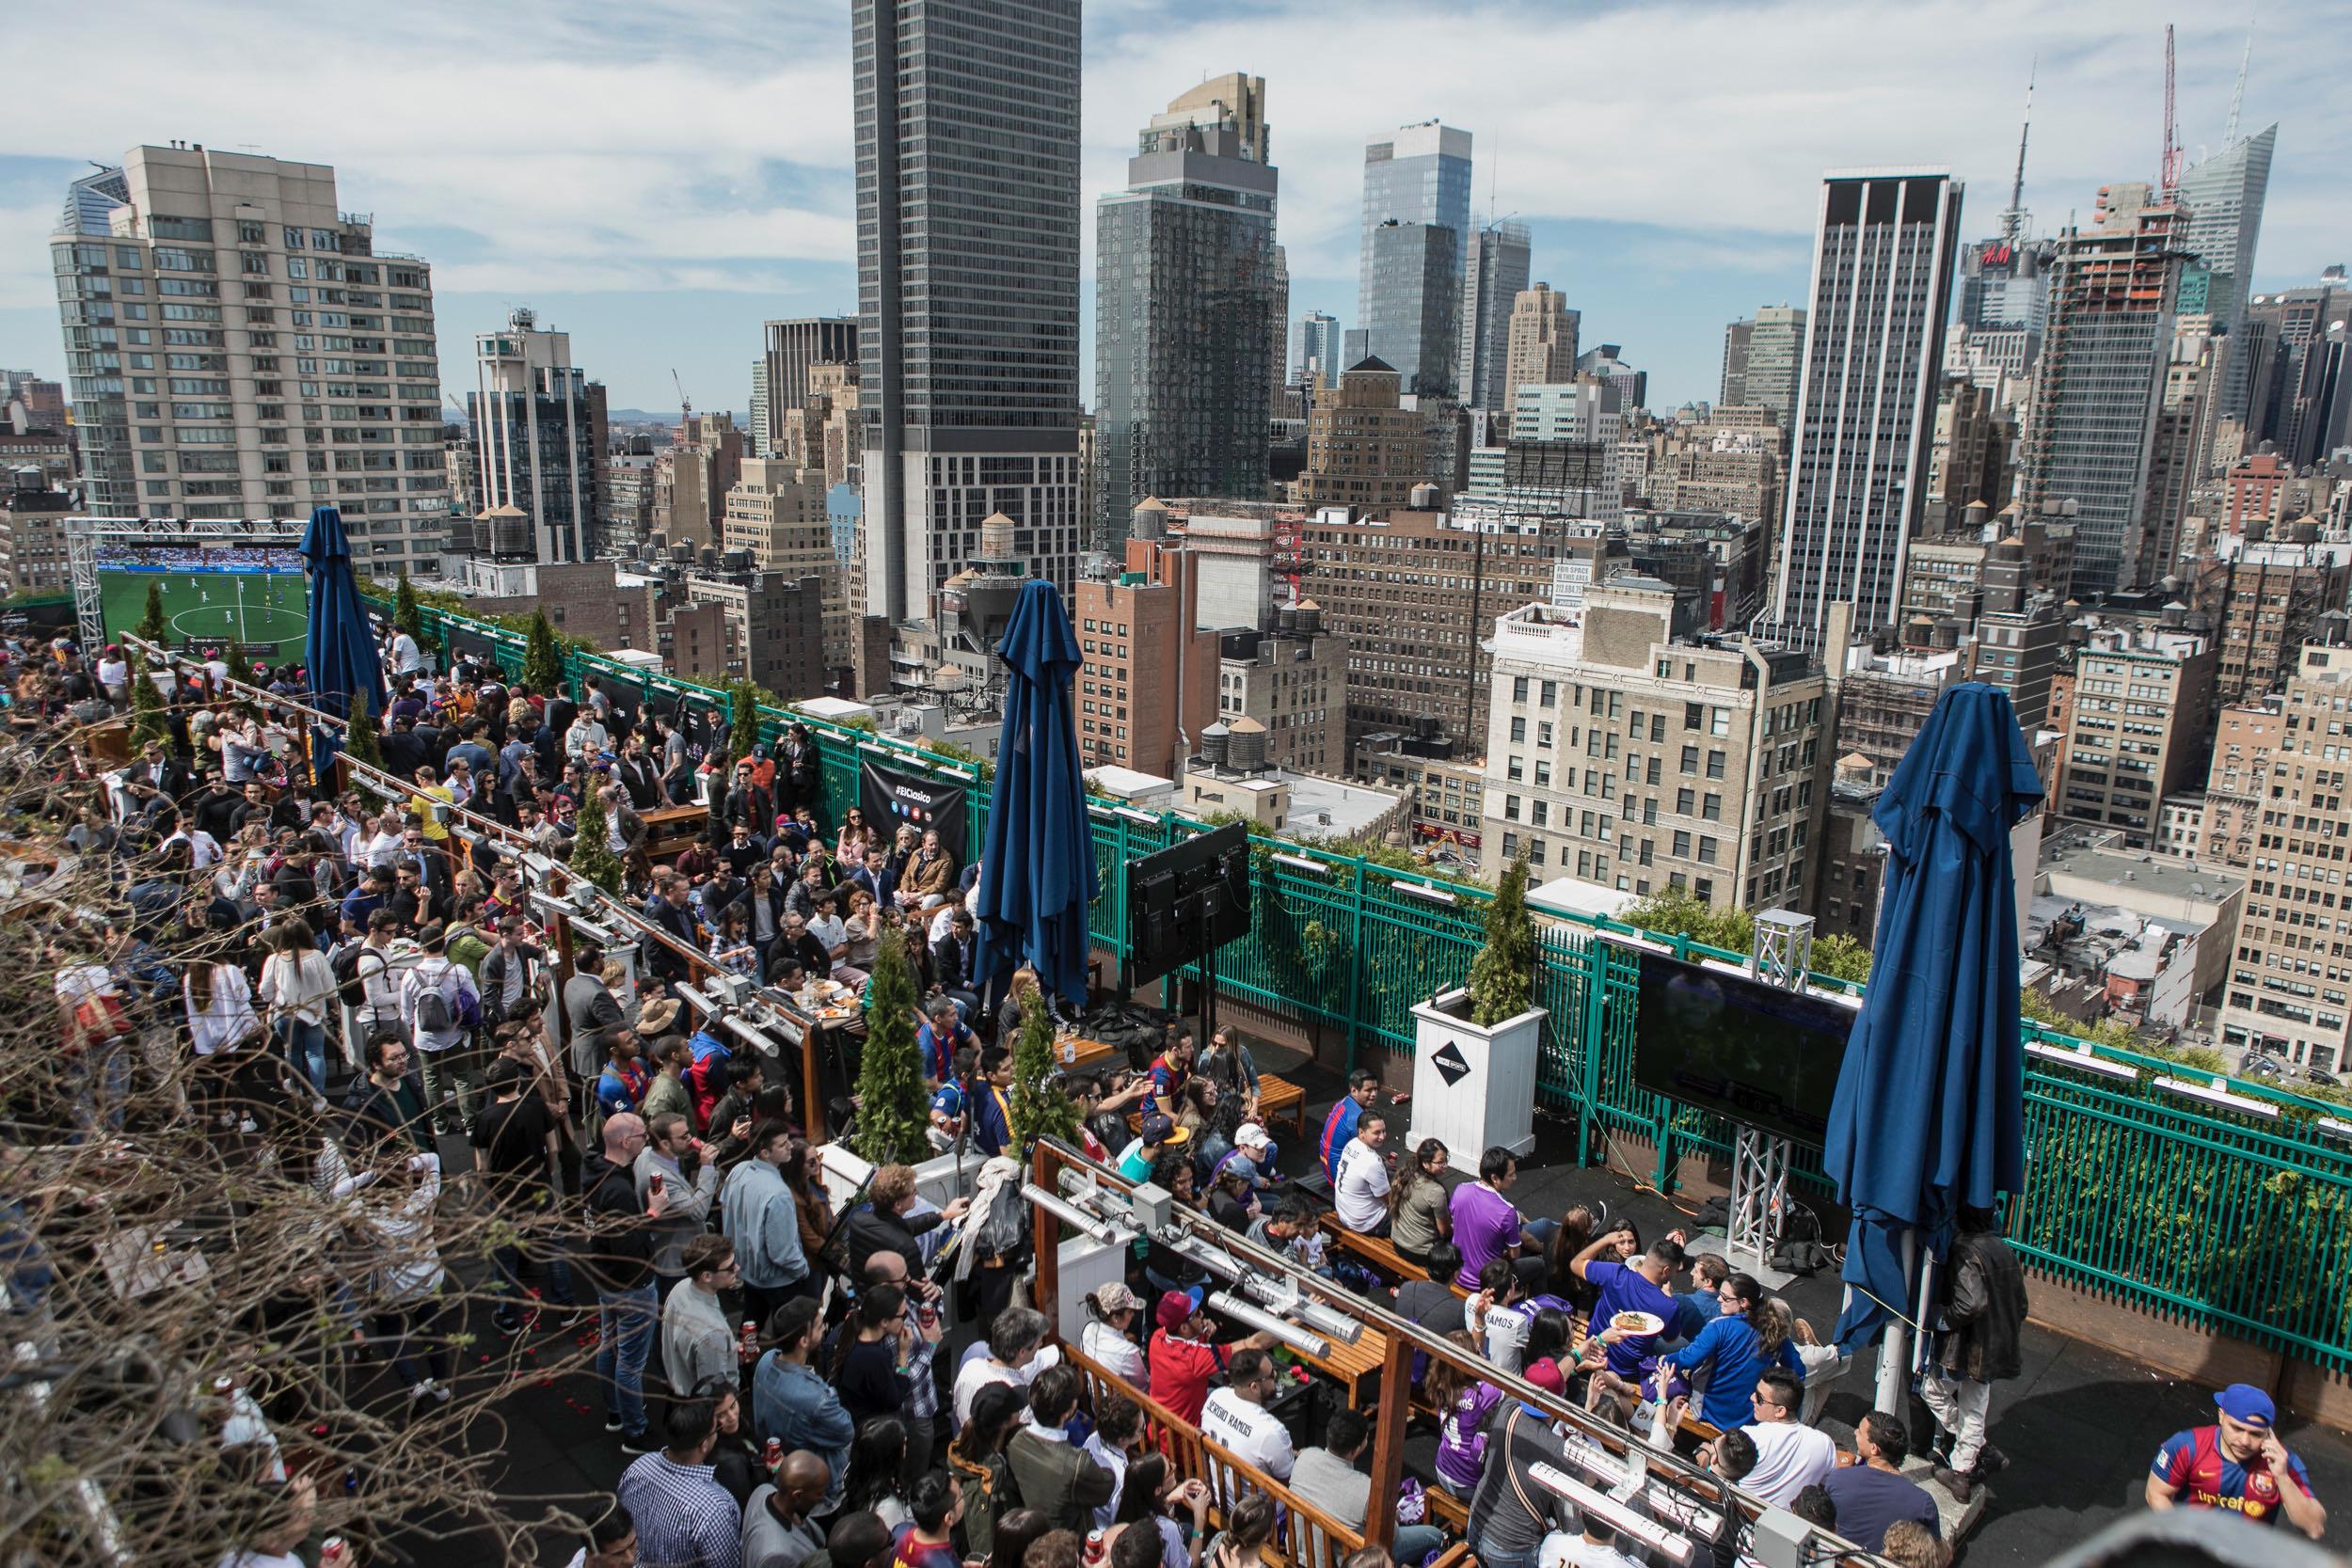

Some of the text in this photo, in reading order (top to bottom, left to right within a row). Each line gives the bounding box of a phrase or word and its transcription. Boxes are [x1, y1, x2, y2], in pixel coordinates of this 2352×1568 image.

[1980, 244, 2011, 264] H&M
[895, 784, 931, 804] #ElClasico
[1206, 1400, 1253, 1437] SERGIO RAMOS
[2198, 1489, 2245, 1512] unicef
